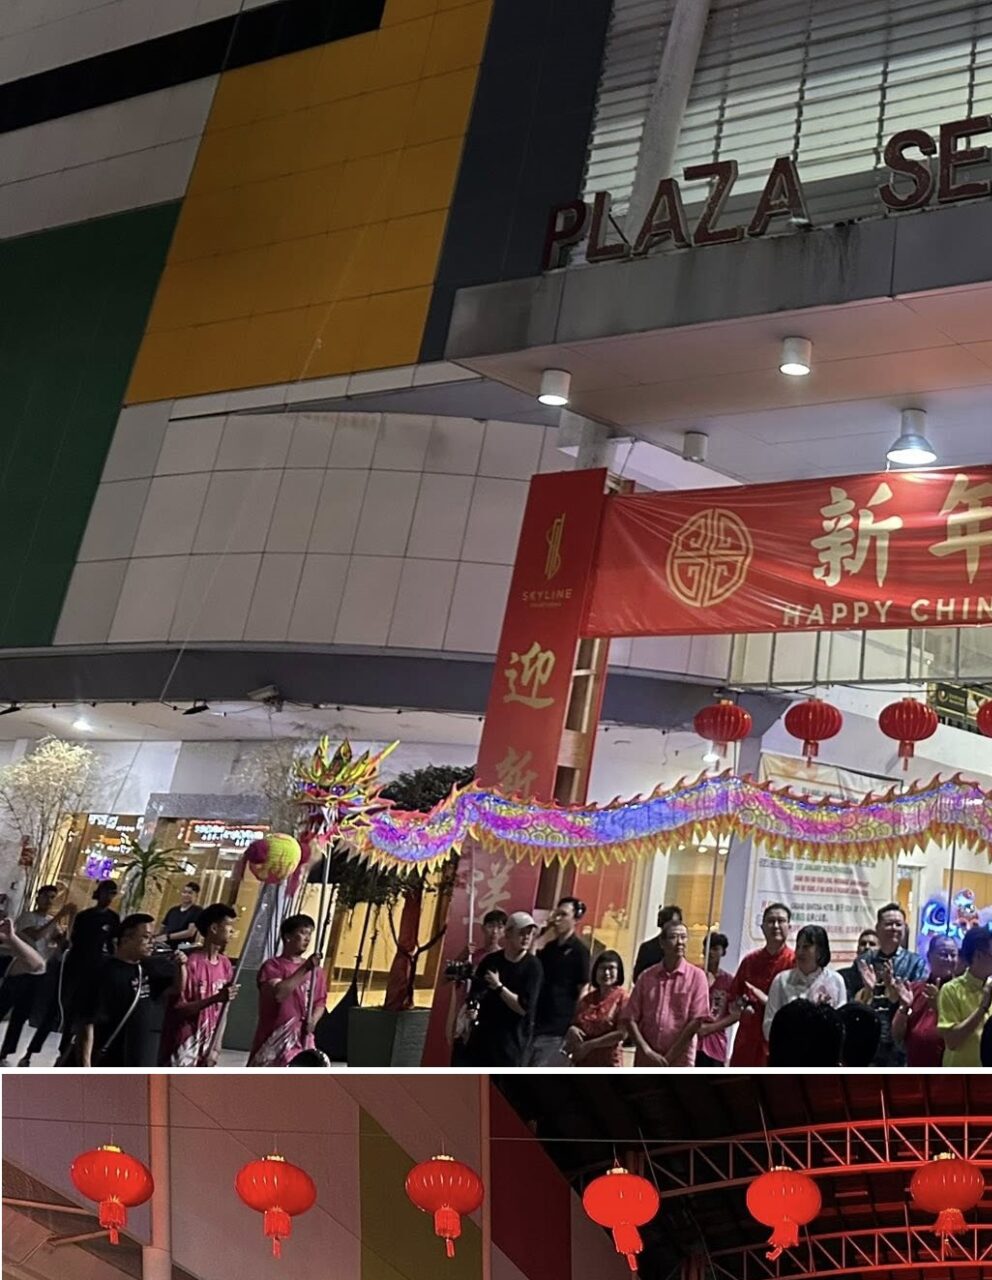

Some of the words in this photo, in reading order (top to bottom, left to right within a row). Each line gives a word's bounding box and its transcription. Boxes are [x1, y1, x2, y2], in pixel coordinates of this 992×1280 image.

[543, 156, 812, 272] PLAZA
[522, 588, 573, 601] SKYLINE
[783, 600, 892, 626] HAPPY
